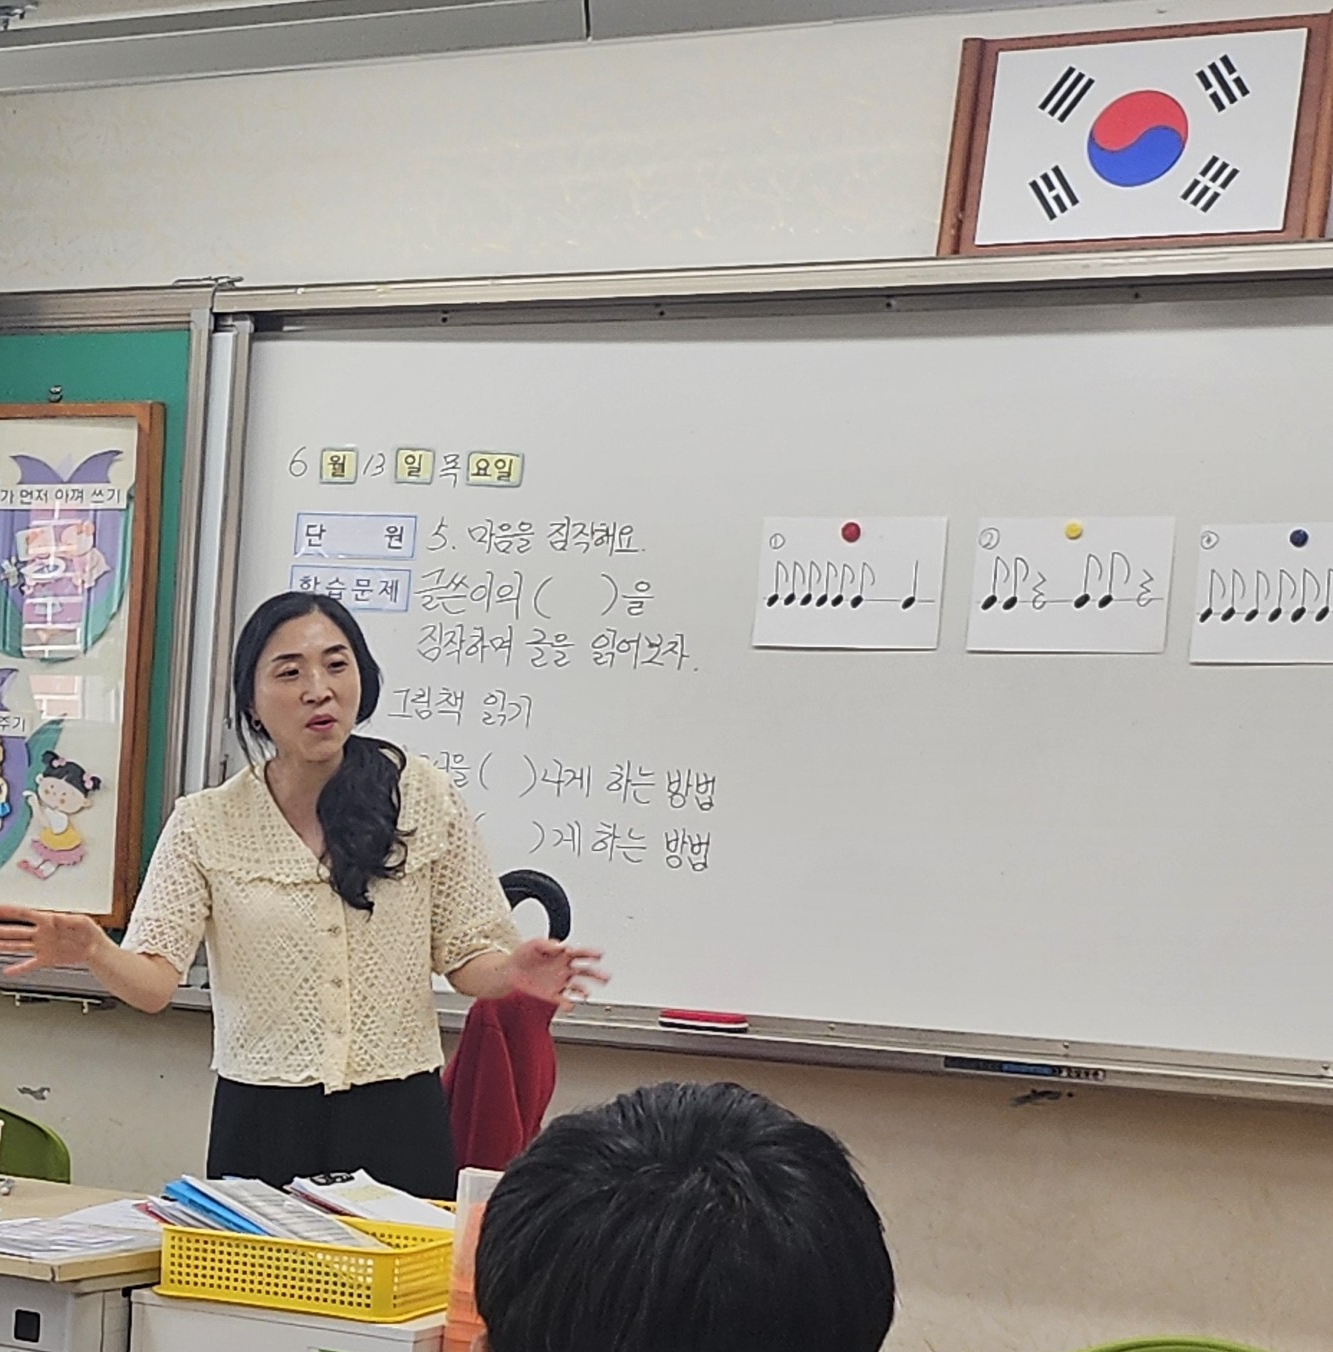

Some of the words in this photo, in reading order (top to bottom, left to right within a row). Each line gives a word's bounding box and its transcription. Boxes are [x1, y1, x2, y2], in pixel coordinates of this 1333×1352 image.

[289, 446, 308, 477] 6
[327, 454, 346, 478] 월
[362, 453, 386, 477] 13
[404, 454, 423, 478] 일
[439, 453, 462, 488] 목
[470, 458, 514, 482] 요일
[20, 487, 49, 506] 먼저
[54, 487, 84, 507] 아껴
[90, 487, 121, 505] 쓰기
[426, 515, 456, 551] 5.
[467, 518, 535, 554] 마음을
[525, 626, 576, 668] 글을
[482, 690, 533, 729] 읽기
[606, 759, 656, 805] 하는
[666, 767, 717, 812] 방법
[591, 820, 648, 864] 하는
[663, 827, 711, 873] 방법
